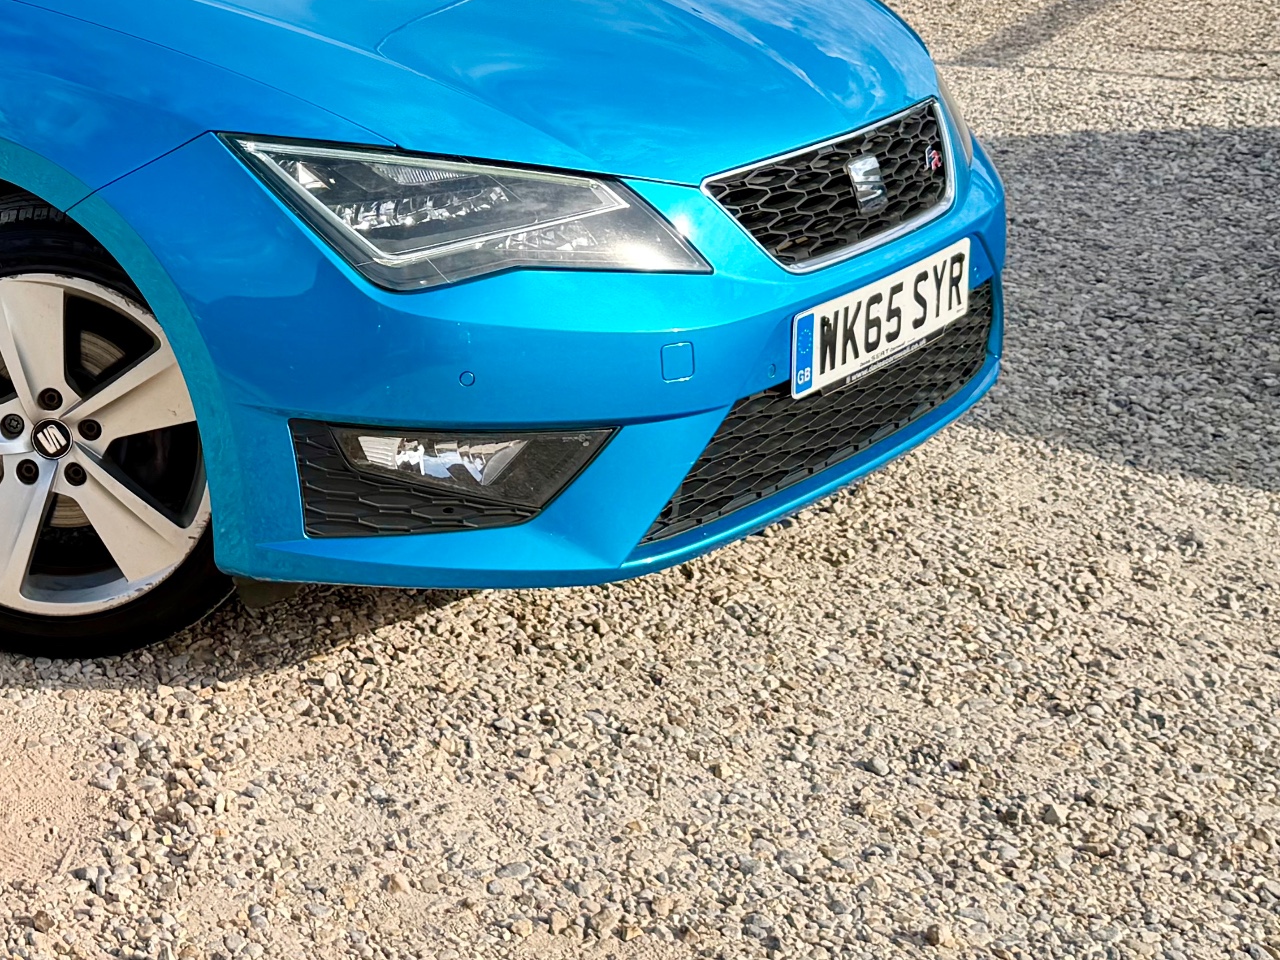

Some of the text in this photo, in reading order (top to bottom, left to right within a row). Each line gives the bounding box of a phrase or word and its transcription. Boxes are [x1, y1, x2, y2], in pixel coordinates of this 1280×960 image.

[819, 251, 966, 376] WK65 SYR
[797, 367, 811, 385] GB
